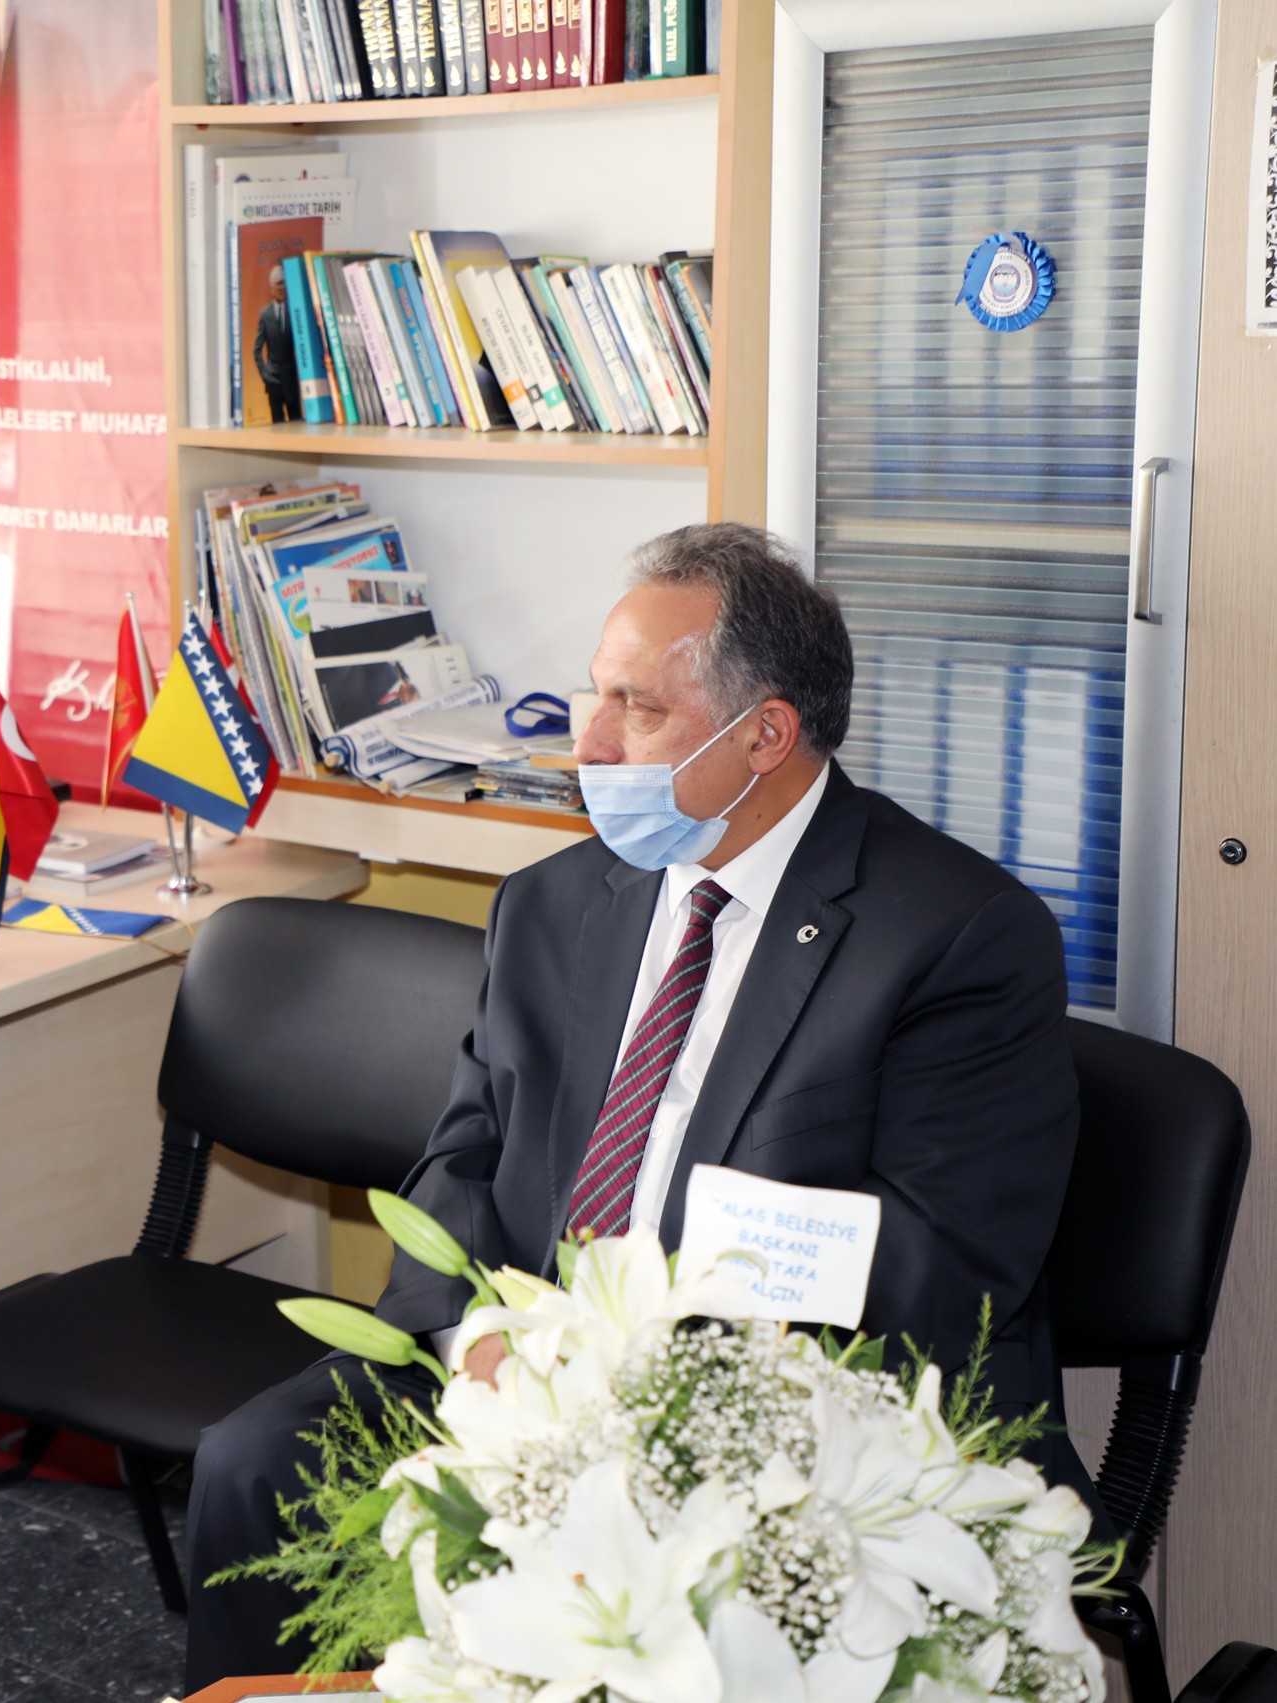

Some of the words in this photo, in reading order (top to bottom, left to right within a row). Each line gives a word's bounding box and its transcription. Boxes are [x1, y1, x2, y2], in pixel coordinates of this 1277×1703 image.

[312, 199, 342, 214] TARİH
[712, 1196, 767, 1223] ALAS
[775, 1211, 858, 1243] BELEDİYE
[738, 1229, 821, 1259] BAŞKANI
[738, 1277, 805, 1304] ALÇIN
